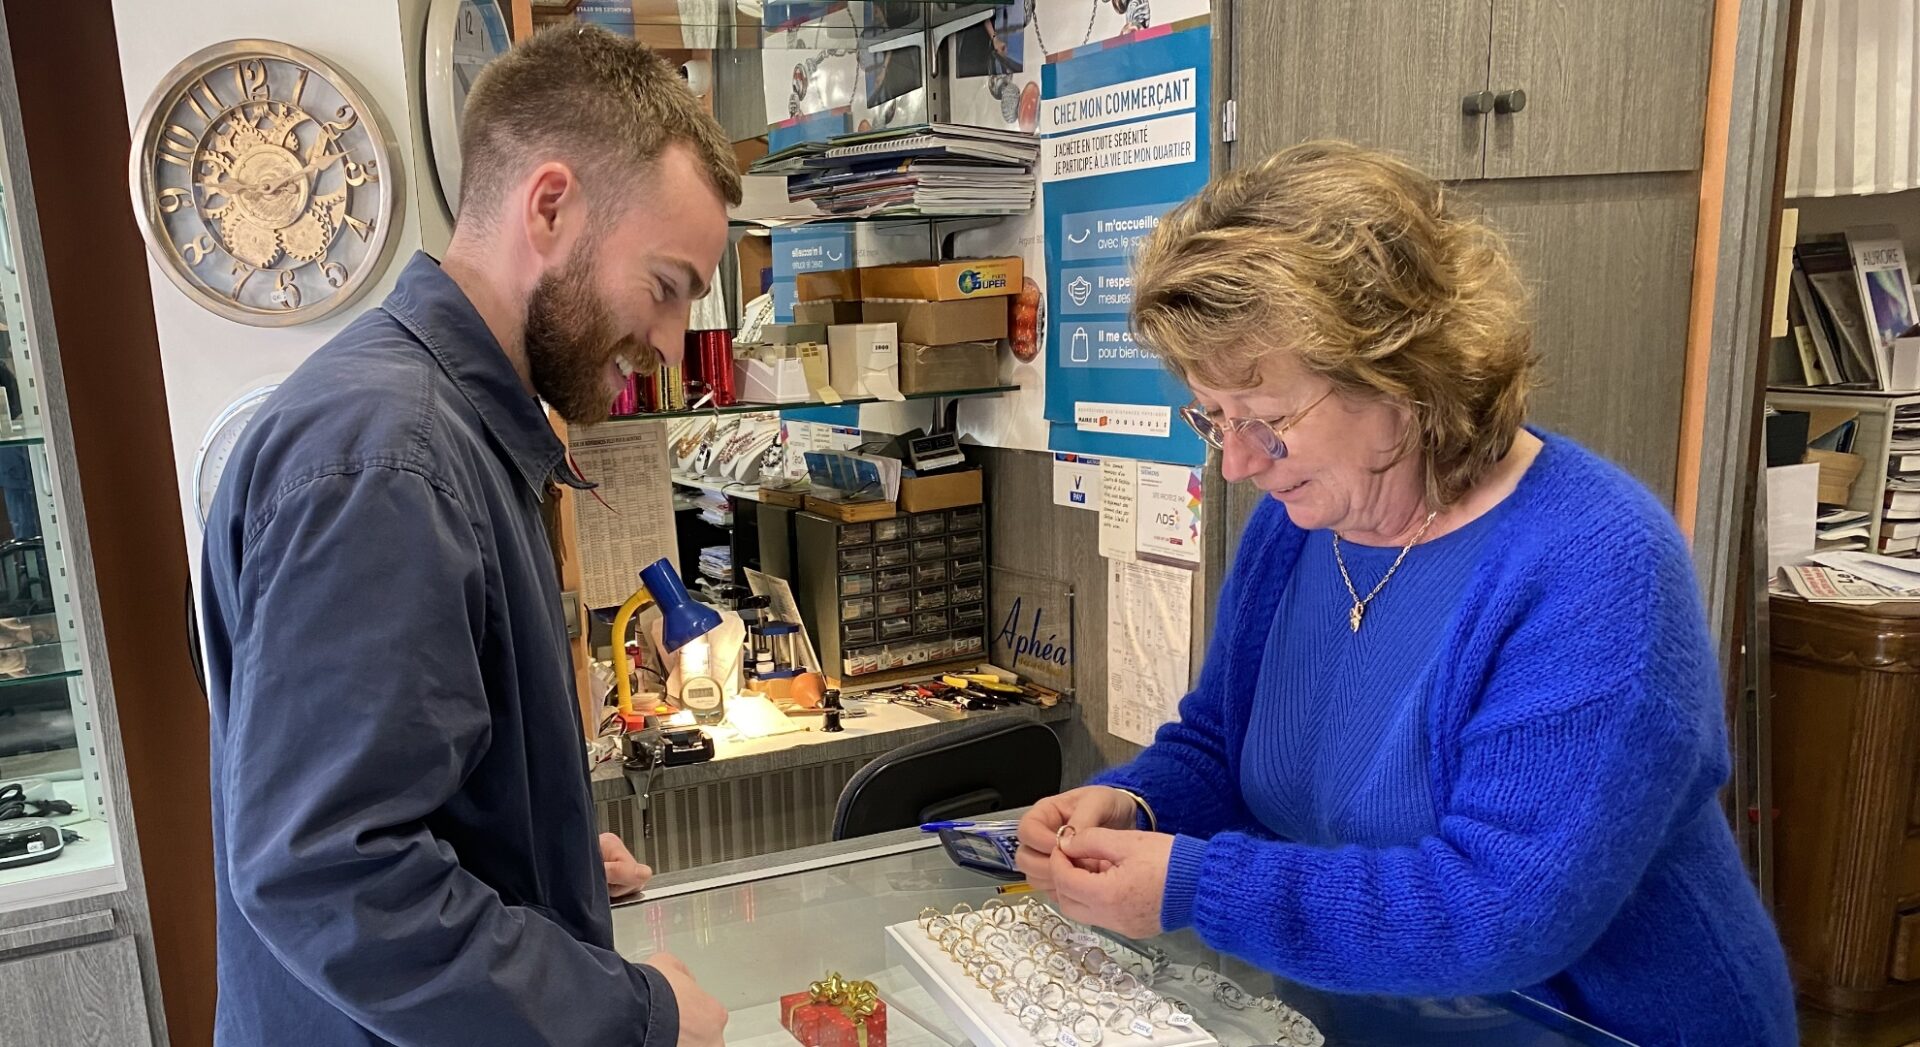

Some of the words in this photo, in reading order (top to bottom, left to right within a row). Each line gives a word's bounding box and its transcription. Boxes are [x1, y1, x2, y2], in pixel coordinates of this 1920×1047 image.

[465, 11, 473, 35] 12
[235, 58, 270, 101] 12
[291, 66, 309, 107] 1
[1053, 103, 1077, 126] CHEZ
[1079, 97, 1103, 121] MON
[1105, 78, 1190, 115] COMMERÇANT
[1082, 138, 1091, 153] EN
[1092, 133, 1112, 151] TOUTE
[1114, 125, 1148, 147] SÉRÉNITÉ
[1054, 160, 1062, 176] JE
[1062, 155, 1093, 174] PARTICIPE
[1094, 153, 1099, 169] À
[1100, 154, 1109, 168] LA
[1110, 151, 1121, 167] VIE
[1123, 150, 1133, 165] DE
[1134, 147, 1151, 163] MON
[1153, 141, 1191, 161] QUARTIER
[344, 160, 379, 187] 3
[157, 187, 195, 214] 9
[343, 212, 376, 243] 4
[1097, 221, 1103, 233] Il
[1105, 215, 1160, 232] m'accueille
[183, 234, 217, 267] 8
[1098, 238, 1119, 249] avec
[1121, 235, 1129, 248] le
[1862, 248, 1900, 267] AURORE
[1098, 276, 1104, 288] Il
[1105, 276, 1131, 290] respe
[1098, 294, 1131, 305] mesures
[1098, 330, 1104, 342] Il
[1105, 332, 1119, 342] me
[1098, 348, 1118, 360] pour
[1119, 346, 1139, 358] bien
[1072, 492, 1083, 502] PAY
[1155, 512, 1175, 526] ADS
[991, 596, 1067, 668] Aphéa
